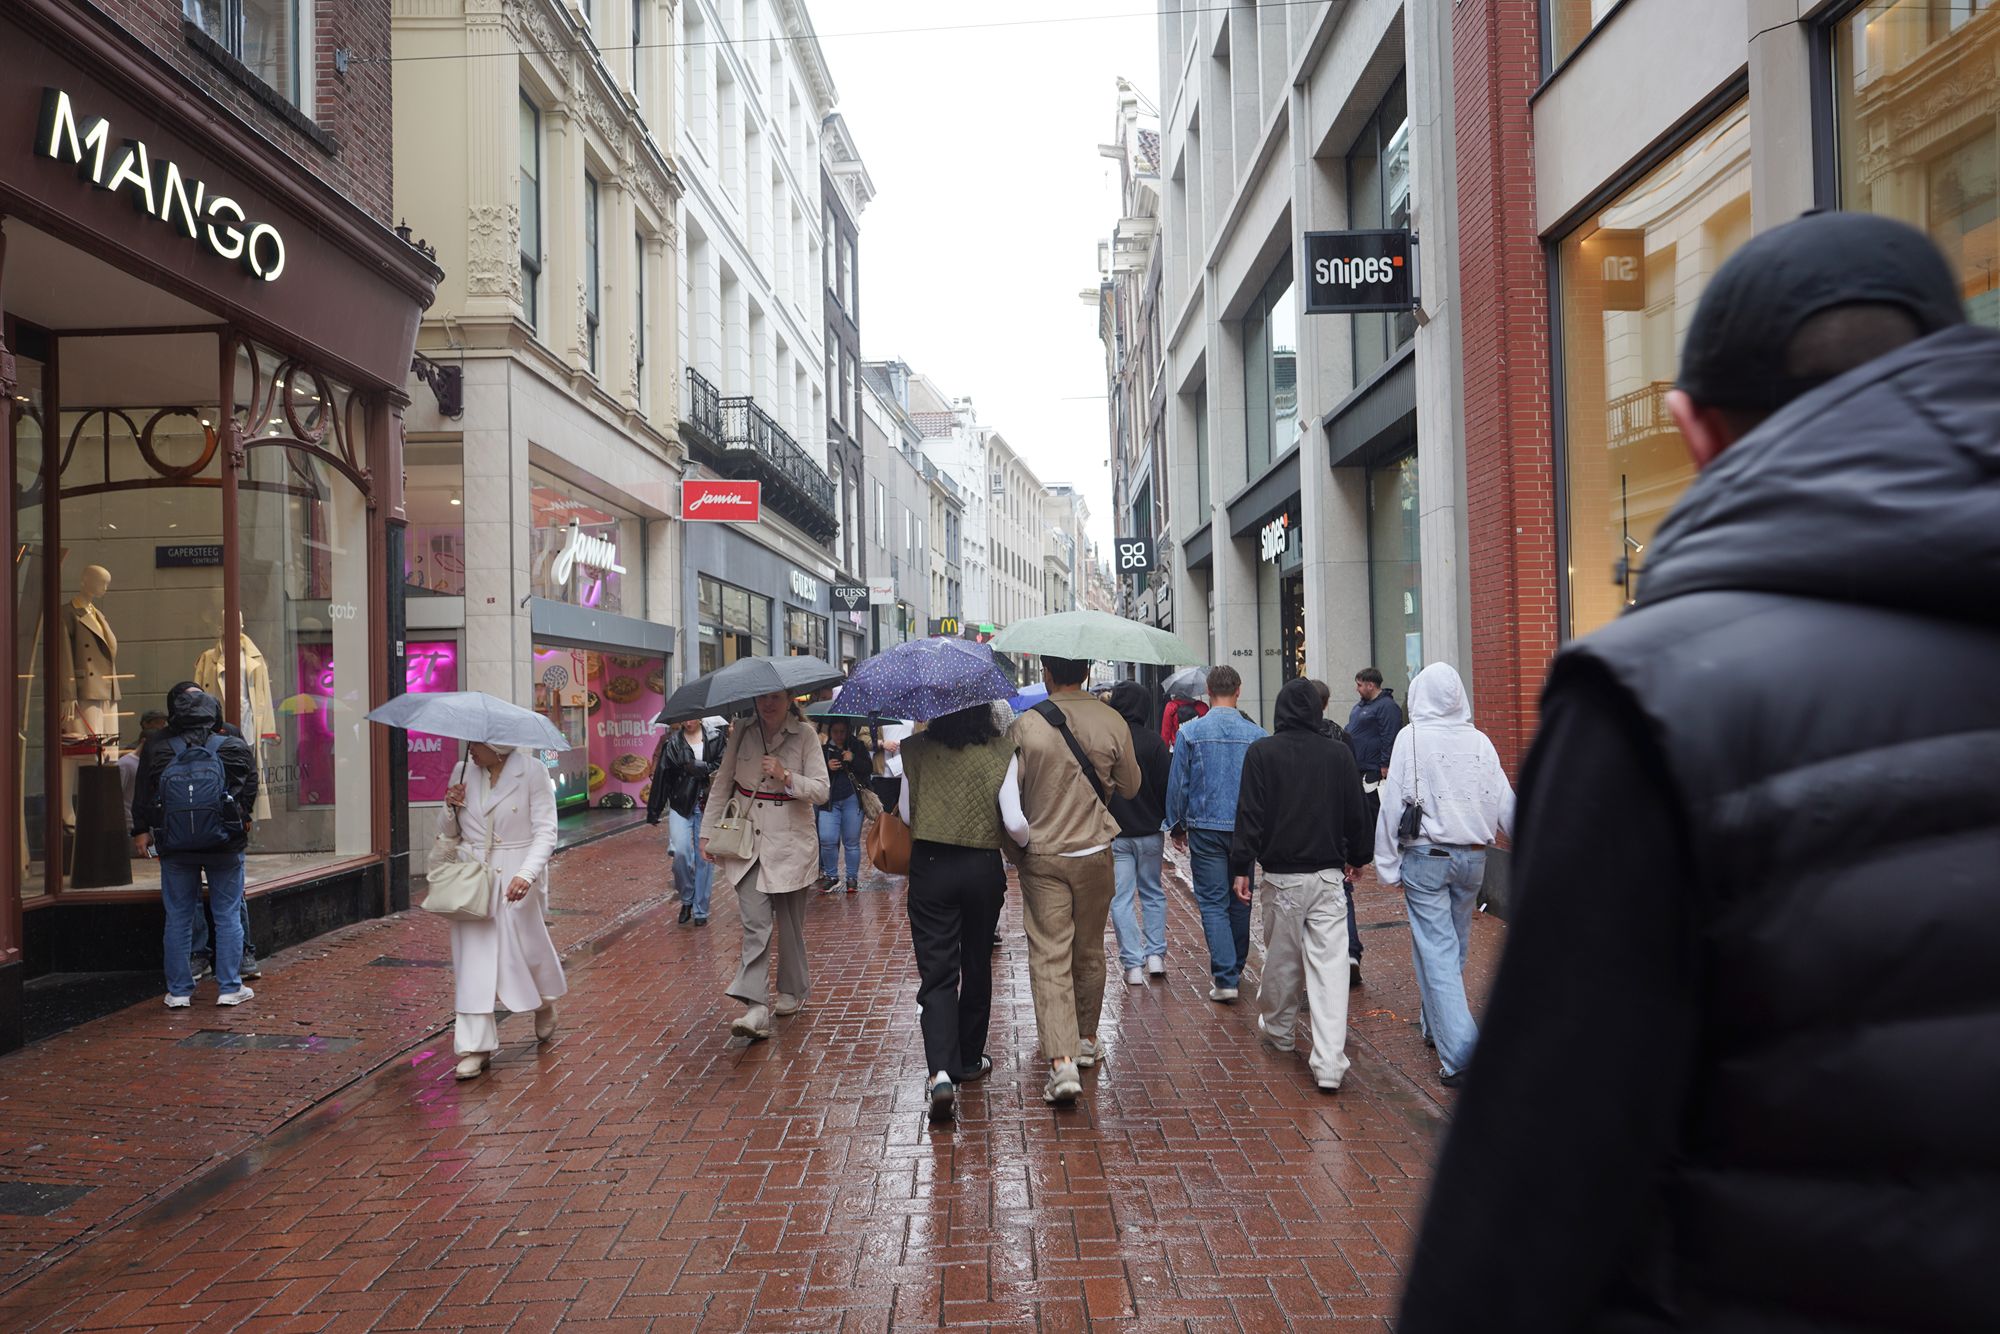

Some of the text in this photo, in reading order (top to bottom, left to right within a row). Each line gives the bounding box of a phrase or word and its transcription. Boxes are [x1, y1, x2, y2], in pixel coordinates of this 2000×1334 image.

[49, 90, 286, 282] MANGO
[1315, 256, 1393, 289] snipes
[689, 490, 752, 511] jamin
[1261, 516, 1286, 564] snipes
[168, 547, 219, 557] GAPERSTEEG
[791, 570, 817, 602] GUESS
[835, 588, 867, 598] GUESS
[1232, 649, 1253, 657] 48-52
[597, 719, 656, 738] CRUMBLE
